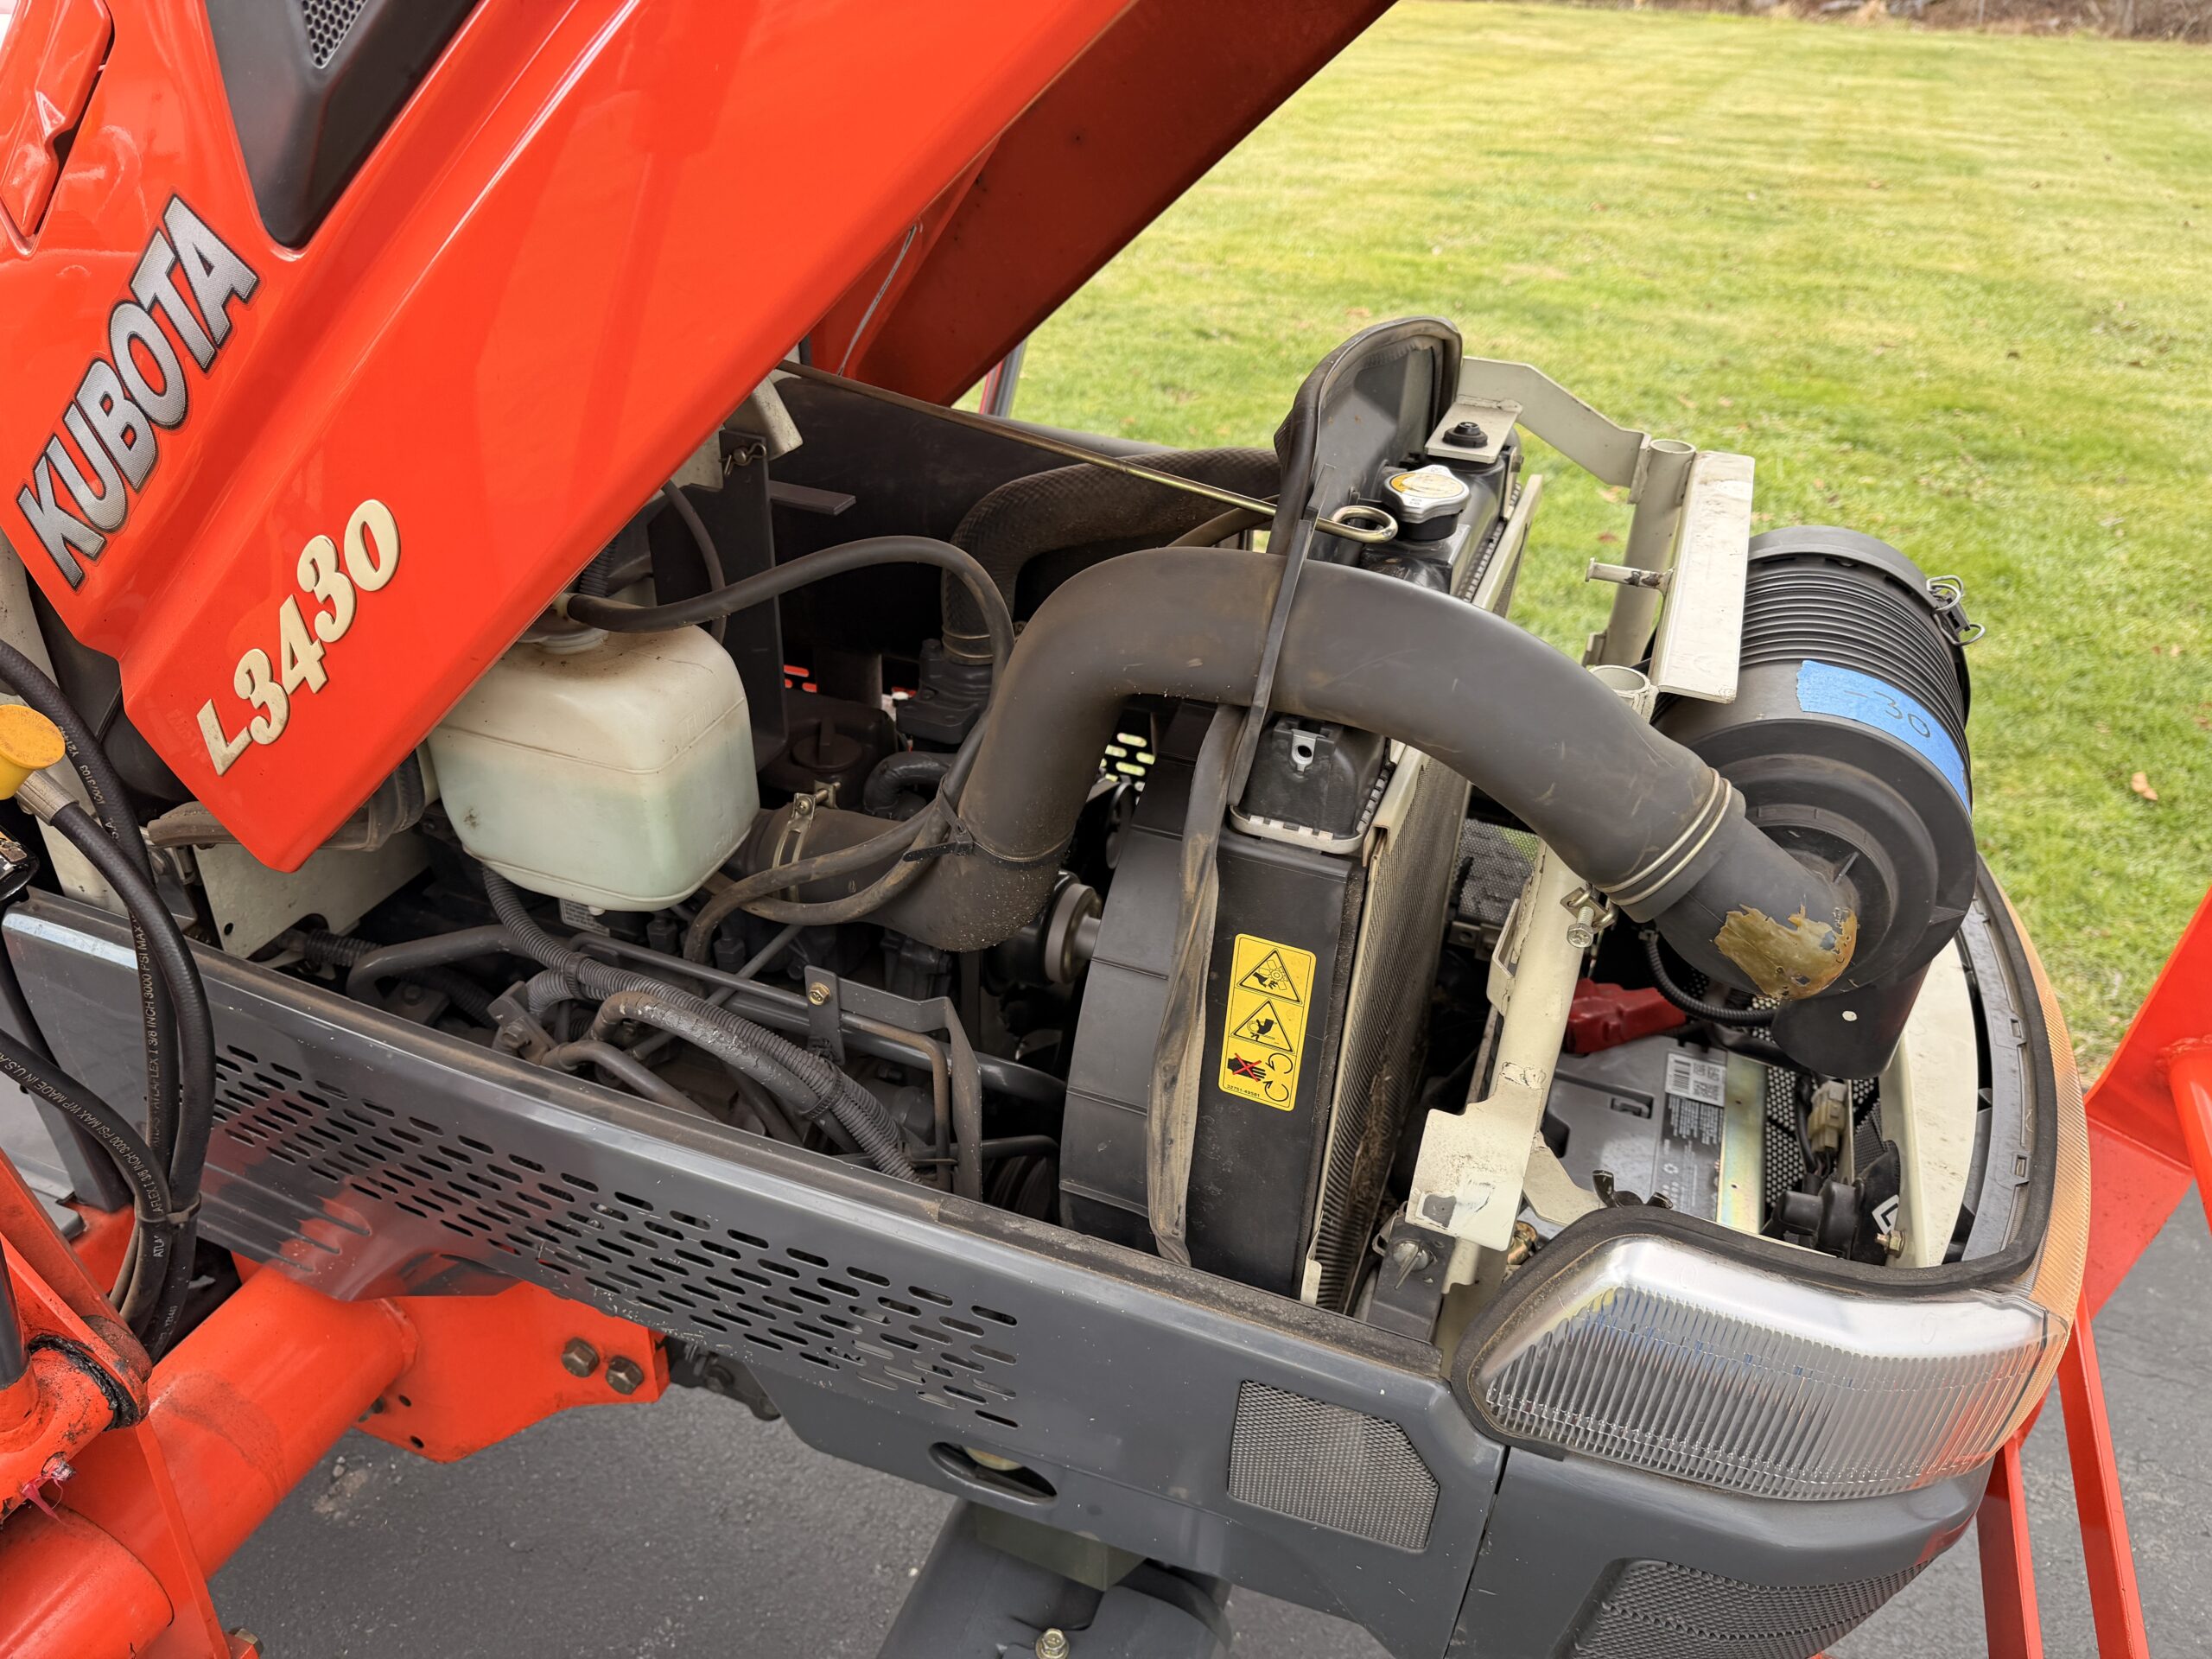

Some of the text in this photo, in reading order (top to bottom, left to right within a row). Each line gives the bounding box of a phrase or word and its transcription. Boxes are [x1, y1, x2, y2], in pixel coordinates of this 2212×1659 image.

[16, 192, 260, 589] KUBOTA
[196, 499, 401, 776] L3430
[133, 926, 147, 950] MAX
[140, 953, 151, 971] PSI
[142, 974, 155, 999] 3000
[144, 1001, 157, 1028] INCH
[147, 1031, 158, 1046] 3/8
[22, 1072, 40, 1084] IN
[34, 1081, 67, 1103] MADE
[62, 1102, 82, 1115] WP
[77, 1109, 102, 1128] MAX
[95, 1126, 114, 1141] PSI
[109, 1136, 129, 1154] 3000
[124, 1151, 145, 1172] INCH
